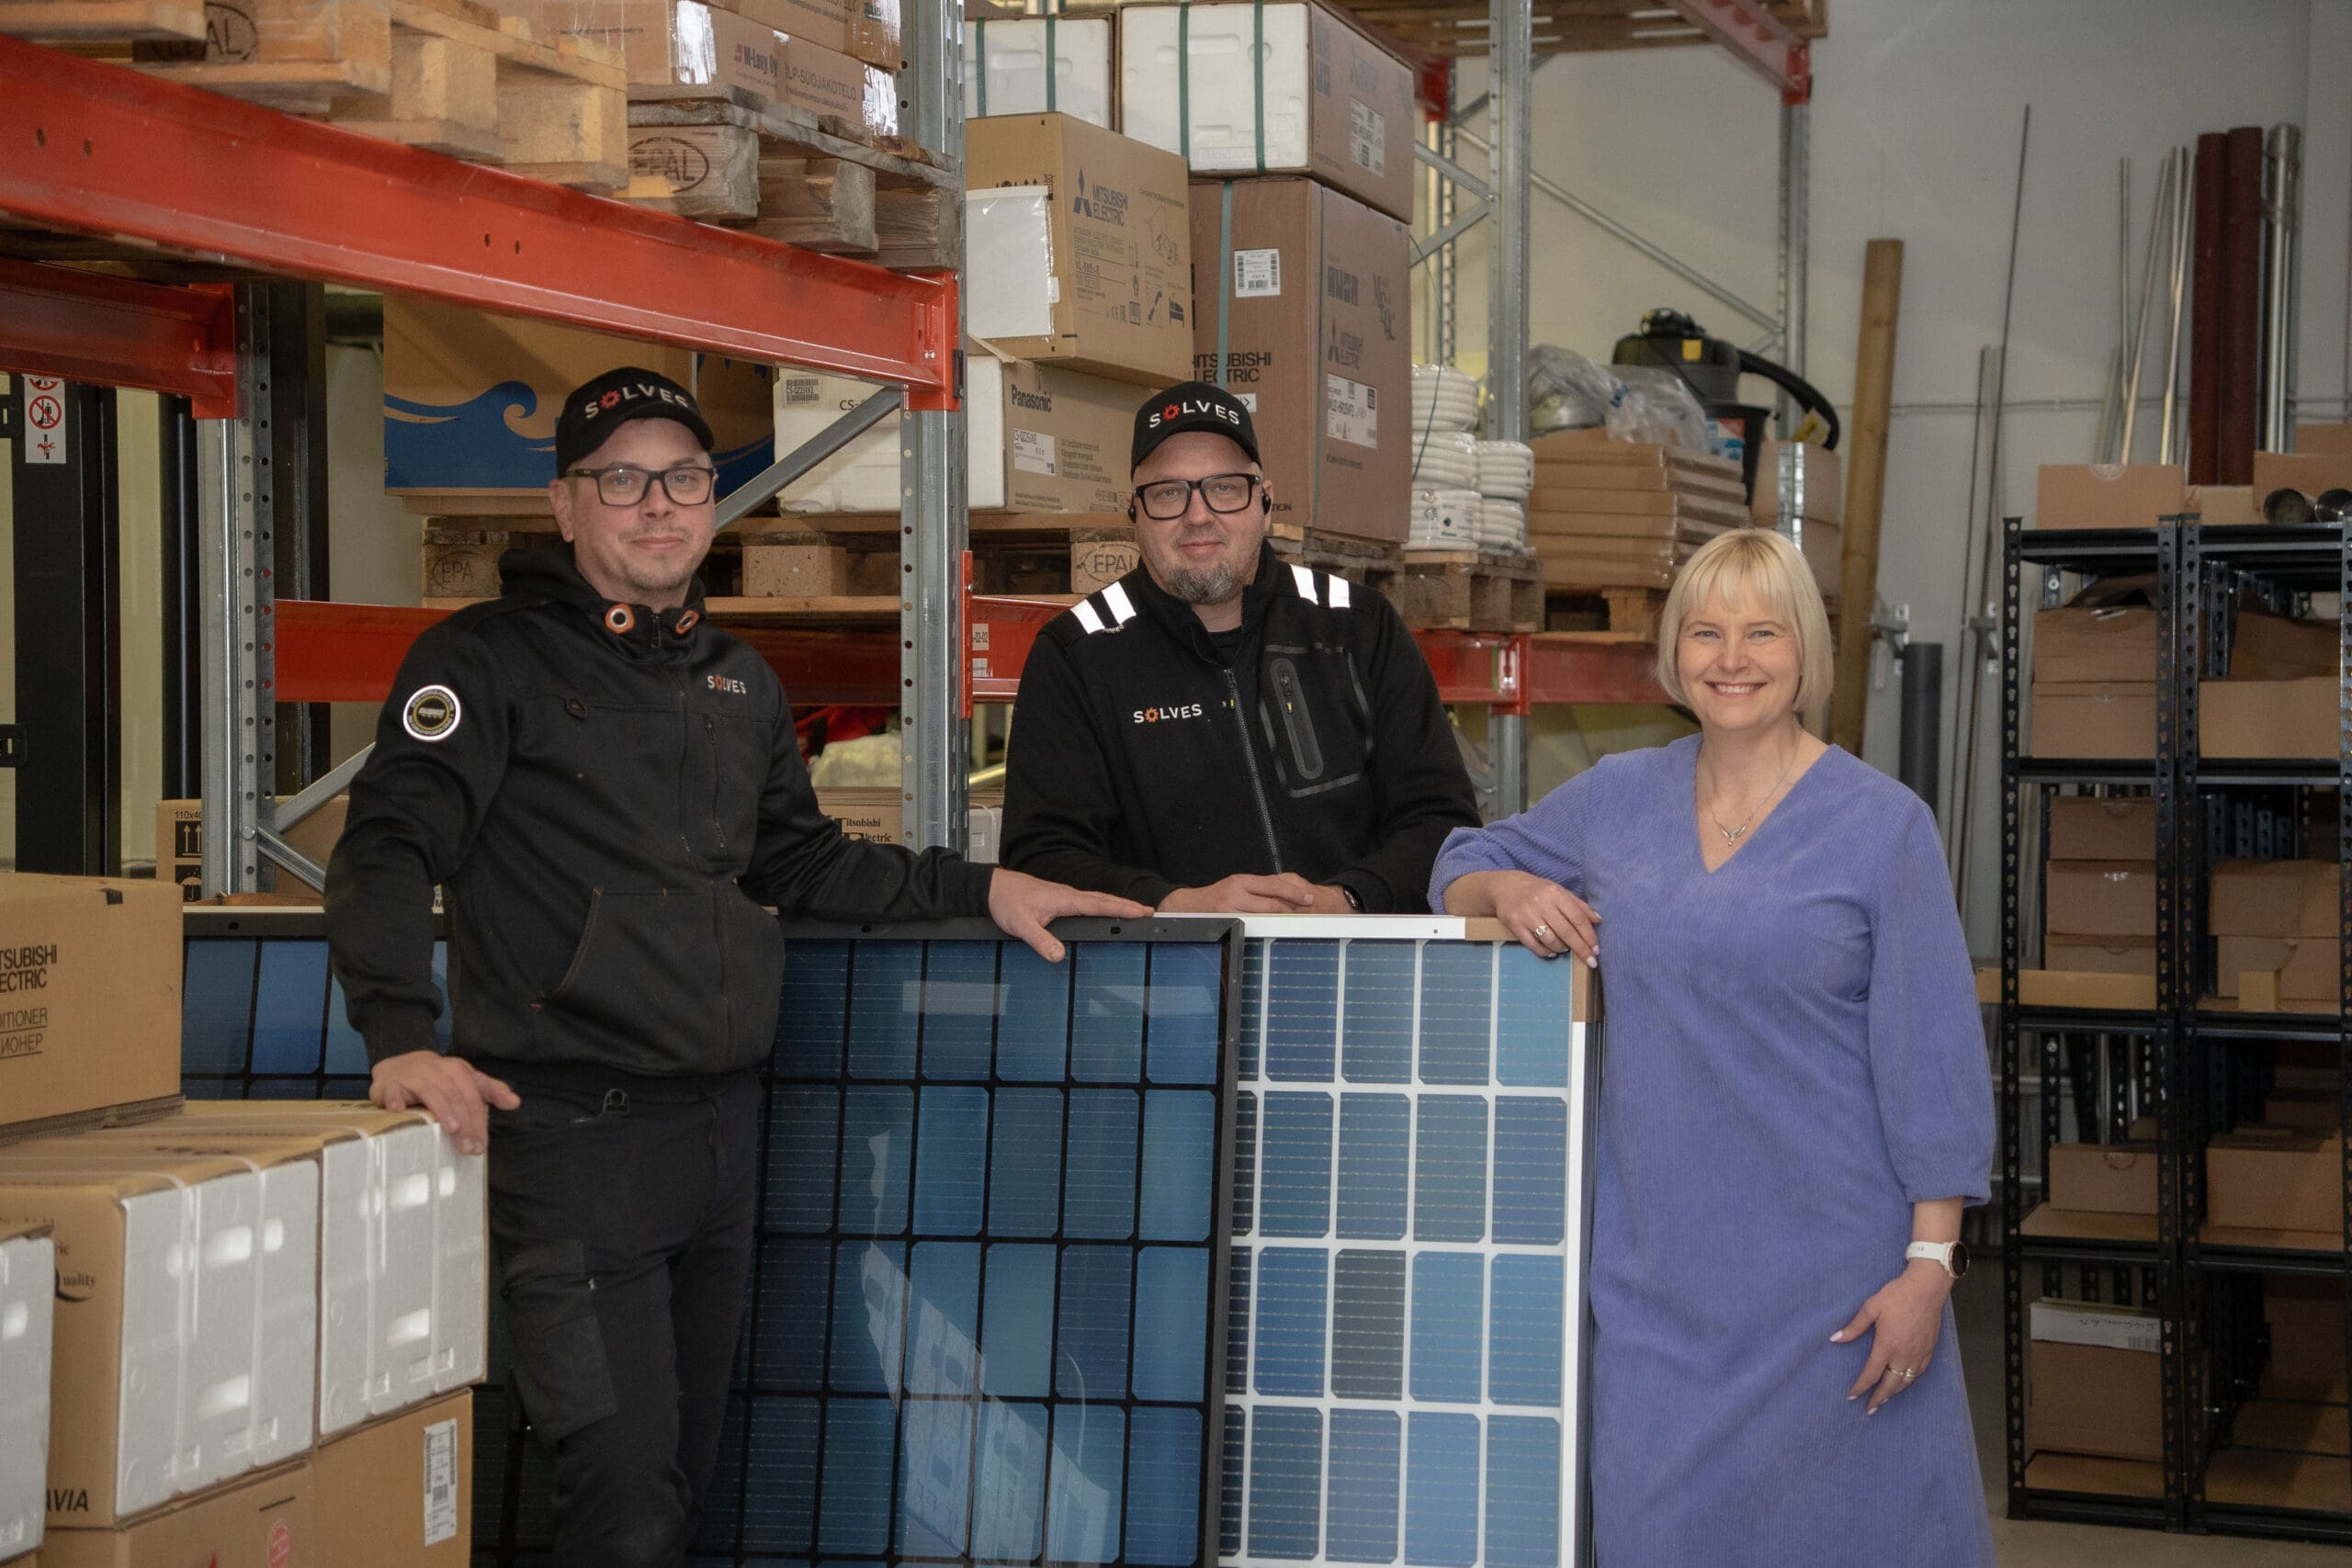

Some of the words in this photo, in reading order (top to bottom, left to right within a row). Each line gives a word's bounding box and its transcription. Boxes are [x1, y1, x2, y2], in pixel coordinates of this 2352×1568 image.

[205, 18, 243, 55] AL
[1092, 184, 1128, 210] MITSUBISHI
[1092, 202, 1125, 227] ELECTRIC
[1192, 352, 1272, 368] ITSUBISHI
[1193, 367, 1260, 383] LETRIC
[585, 383, 689, 419] SOLVES
[839, 399, 865, 412] CS-
[1012, 384, 1052, 412] Panasonic
[1149, 400, 1239, 428] SOLVES
[707, 675, 746, 694] SOLVES
[1133, 704, 1203, 724] SOLVES
